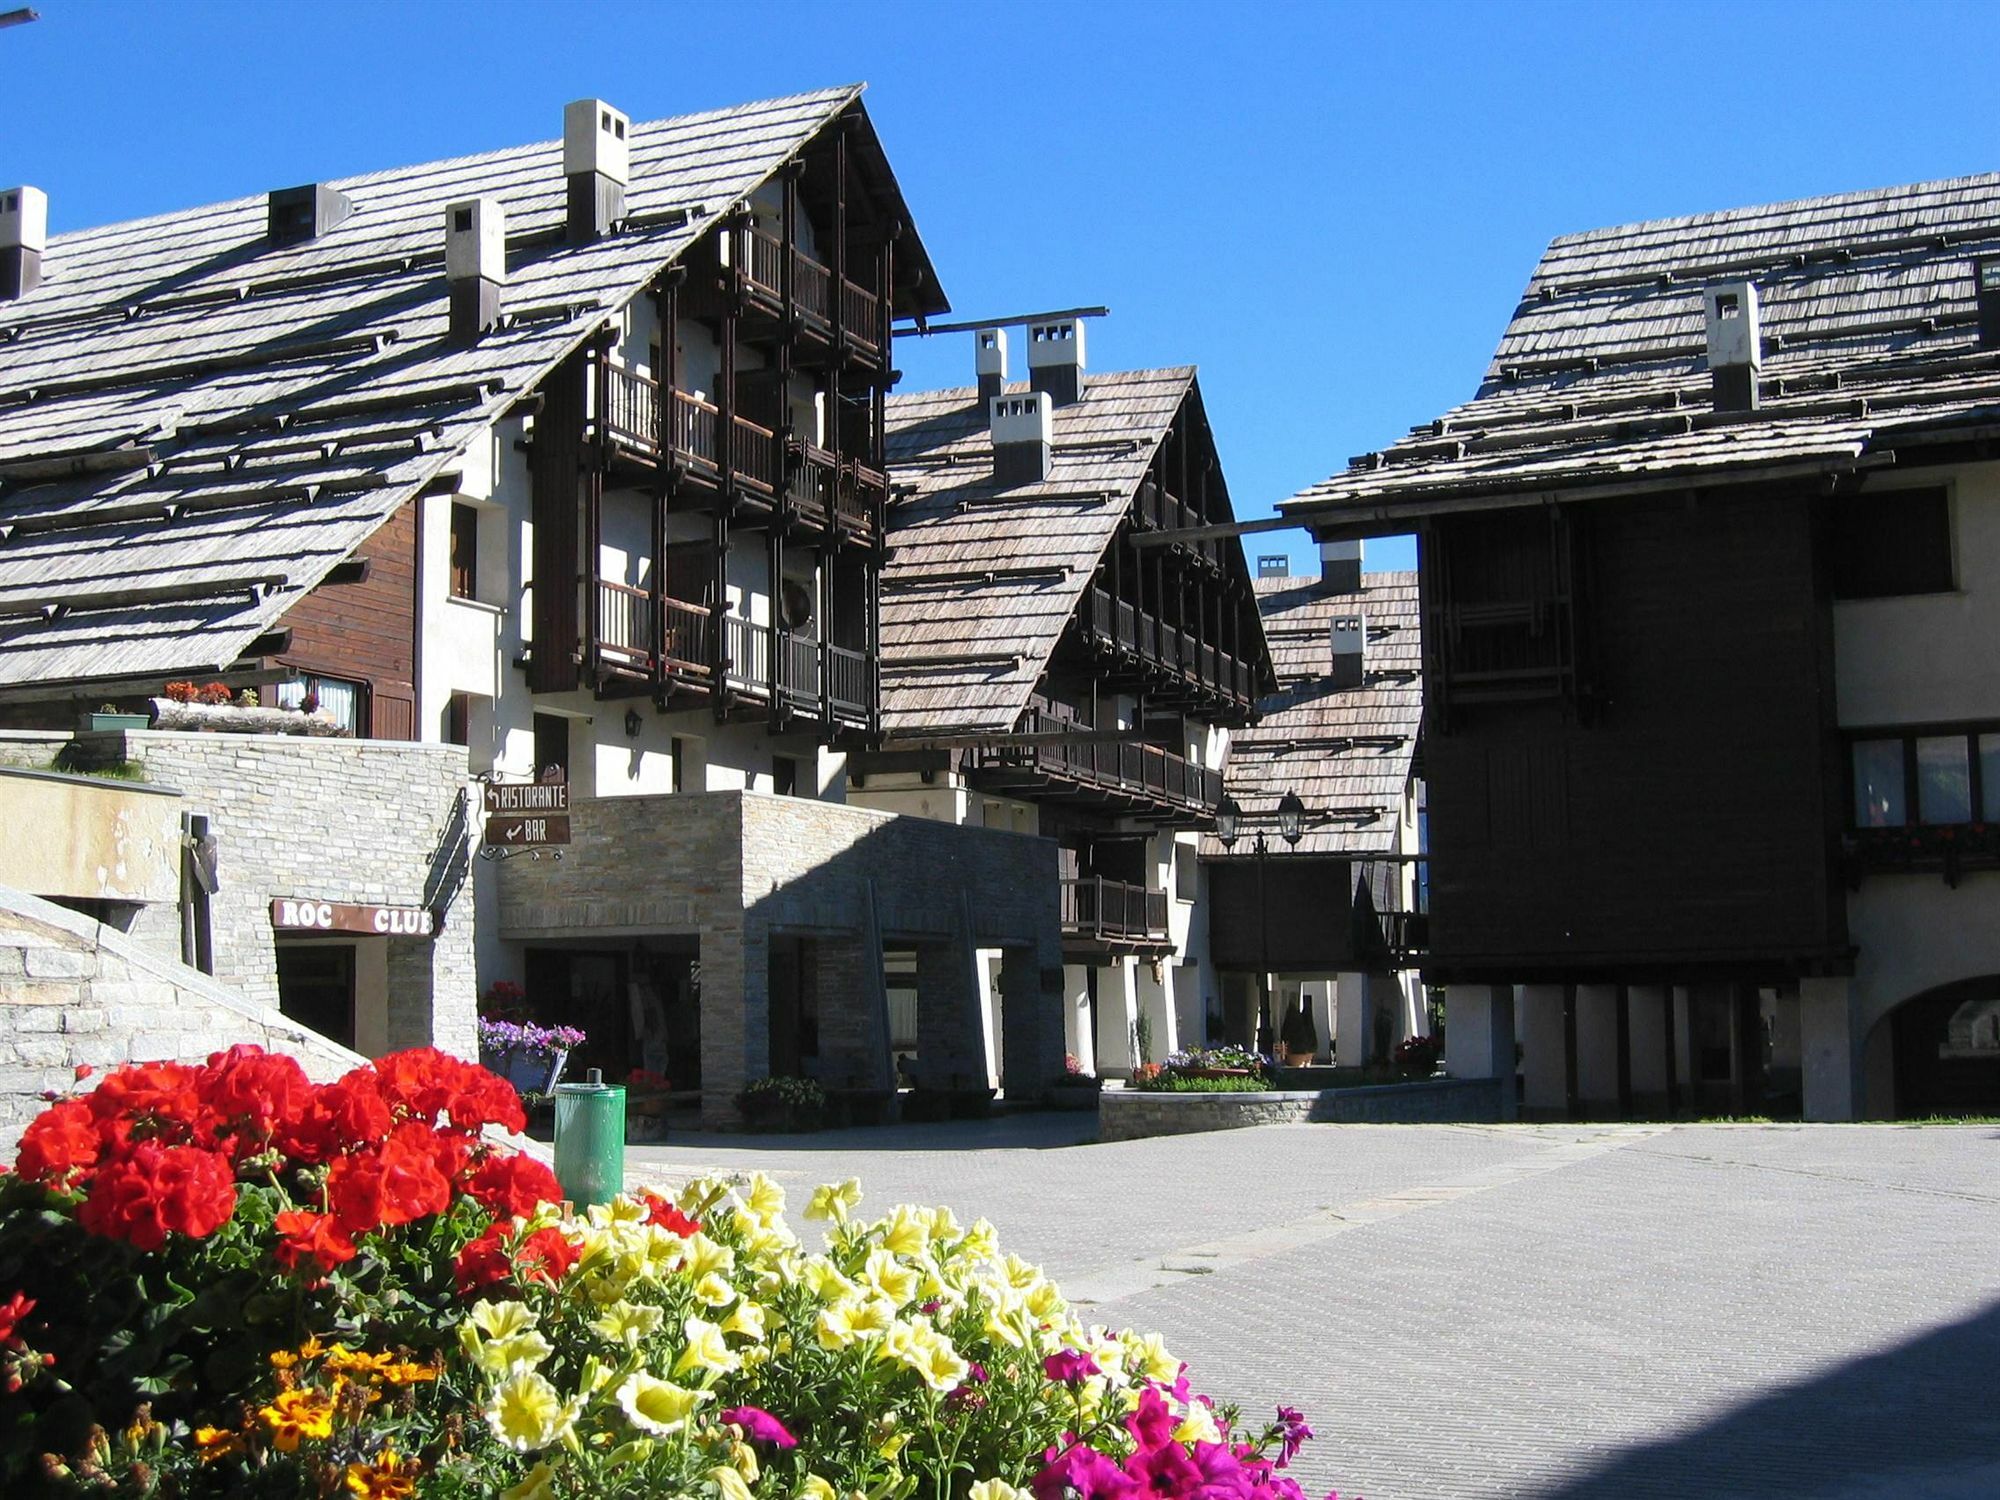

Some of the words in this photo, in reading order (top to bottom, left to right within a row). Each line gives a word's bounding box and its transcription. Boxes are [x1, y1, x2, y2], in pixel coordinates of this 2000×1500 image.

[501, 785, 566, 809] RISTORANTE
[525, 819, 547, 841] BAR
[282, 901, 332, 928] ROC
[374, 910, 434, 935] CLUB
